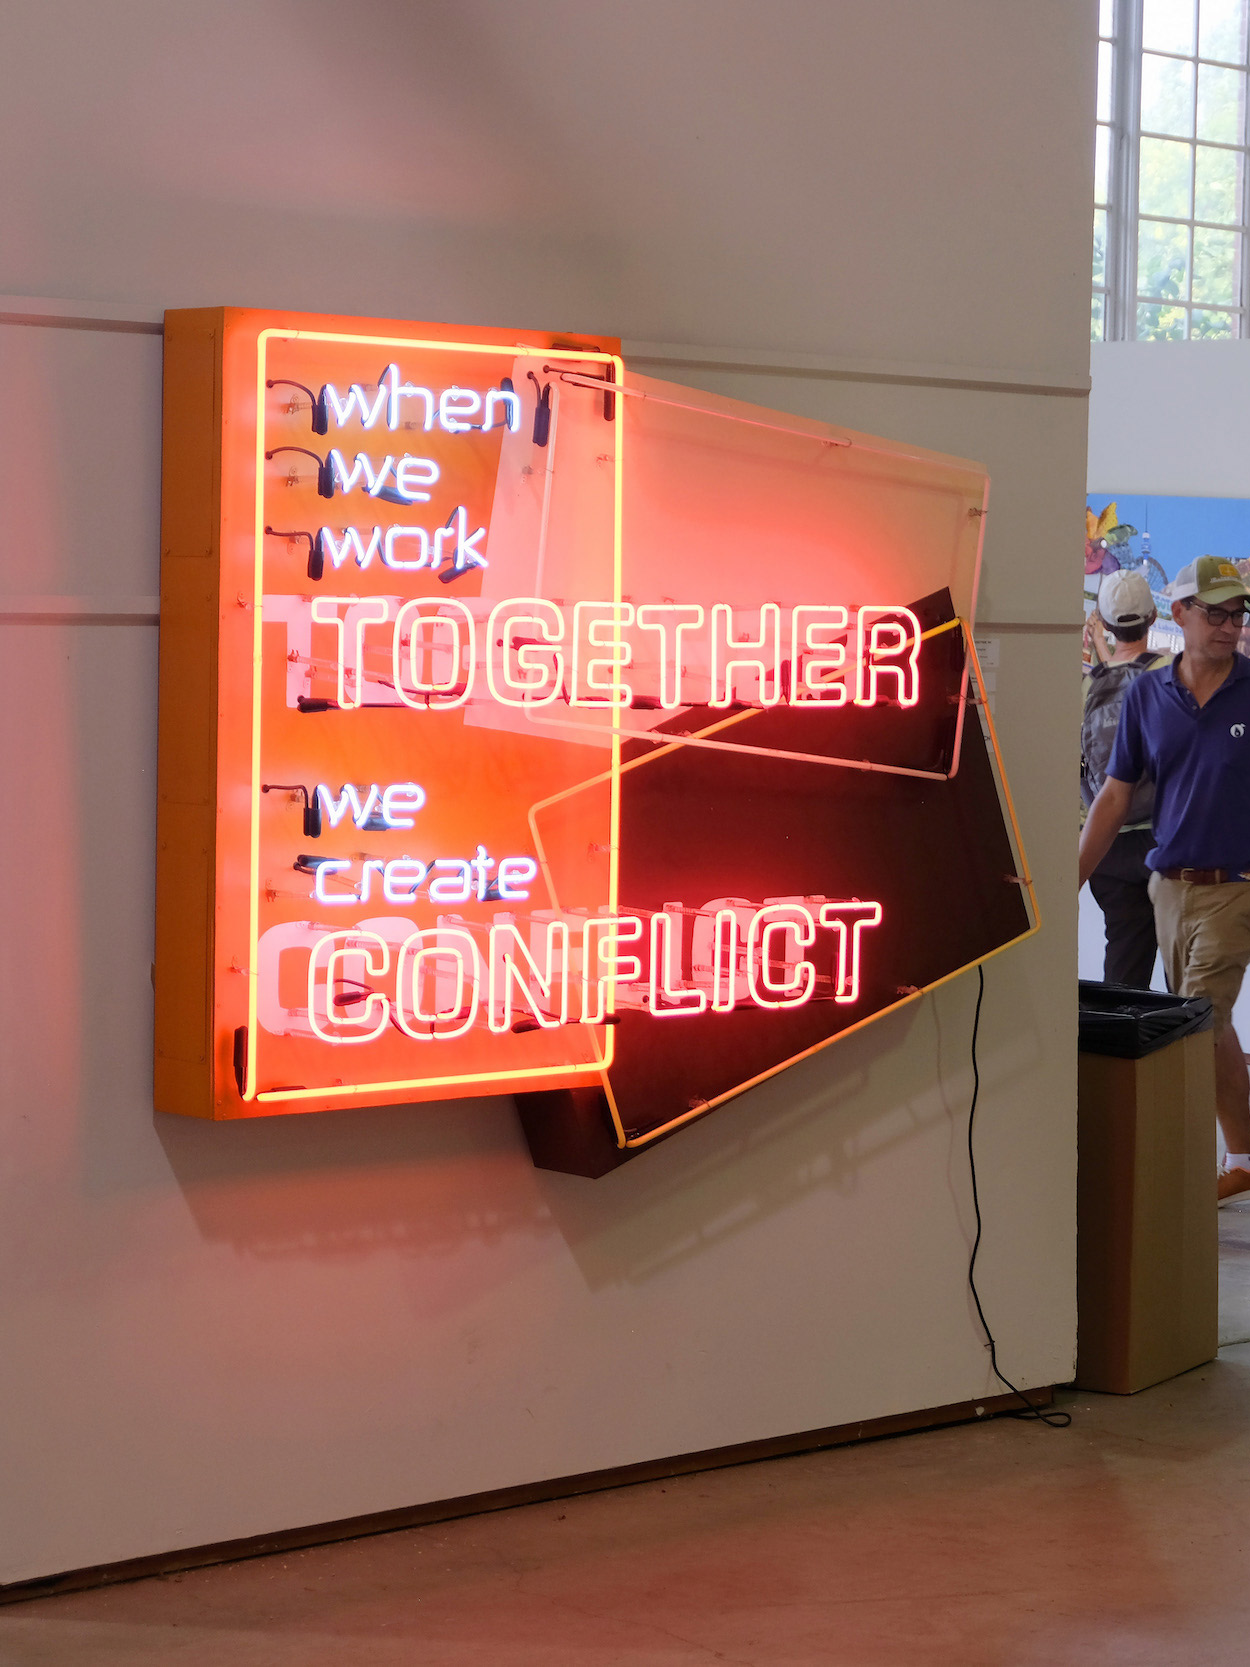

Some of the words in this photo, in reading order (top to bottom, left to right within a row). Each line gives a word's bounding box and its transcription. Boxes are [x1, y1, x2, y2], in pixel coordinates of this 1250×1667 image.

[323, 363, 521, 432] when
[328, 447, 440, 501] we
[320, 505, 489, 569] work
[309, 596, 923, 710] TOGETHER
[313, 780, 427, 829] we
[314, 844, 537, 903] create
[305, 902, 883, 1046] CONFLICT
